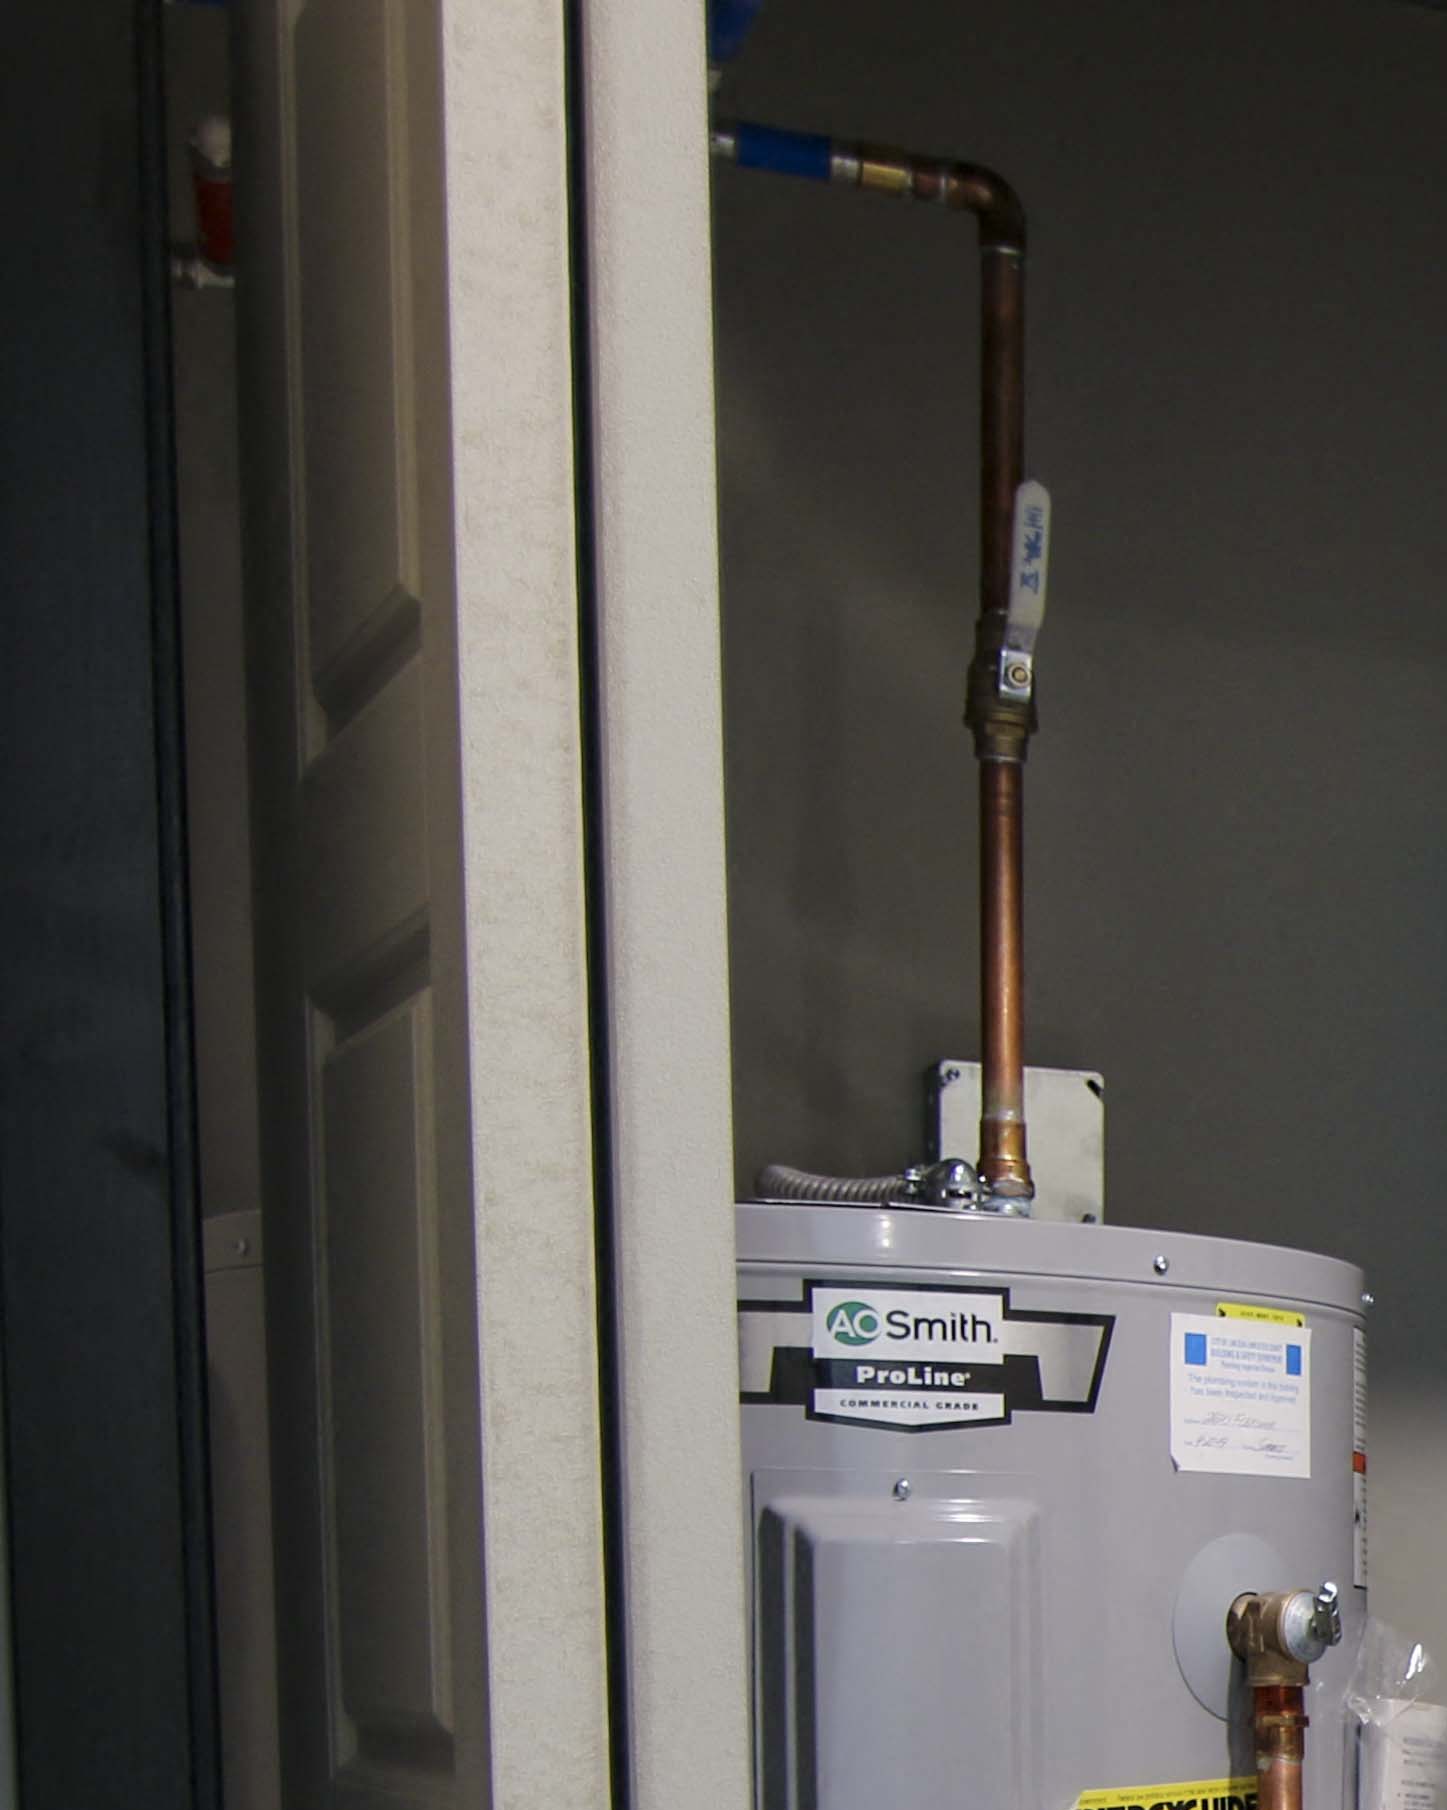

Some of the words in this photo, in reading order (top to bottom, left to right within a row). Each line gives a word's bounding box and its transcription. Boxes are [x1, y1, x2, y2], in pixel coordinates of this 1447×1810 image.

[830, 1308, 882, 1339] AO
[886, 1310, 992, 1343] Smith
[857, 1366, 965, 1386] ProLine
[840, 1399, 929, 1409] COMMERCIAL
[936, 1402, 978, 1411] GRADE
